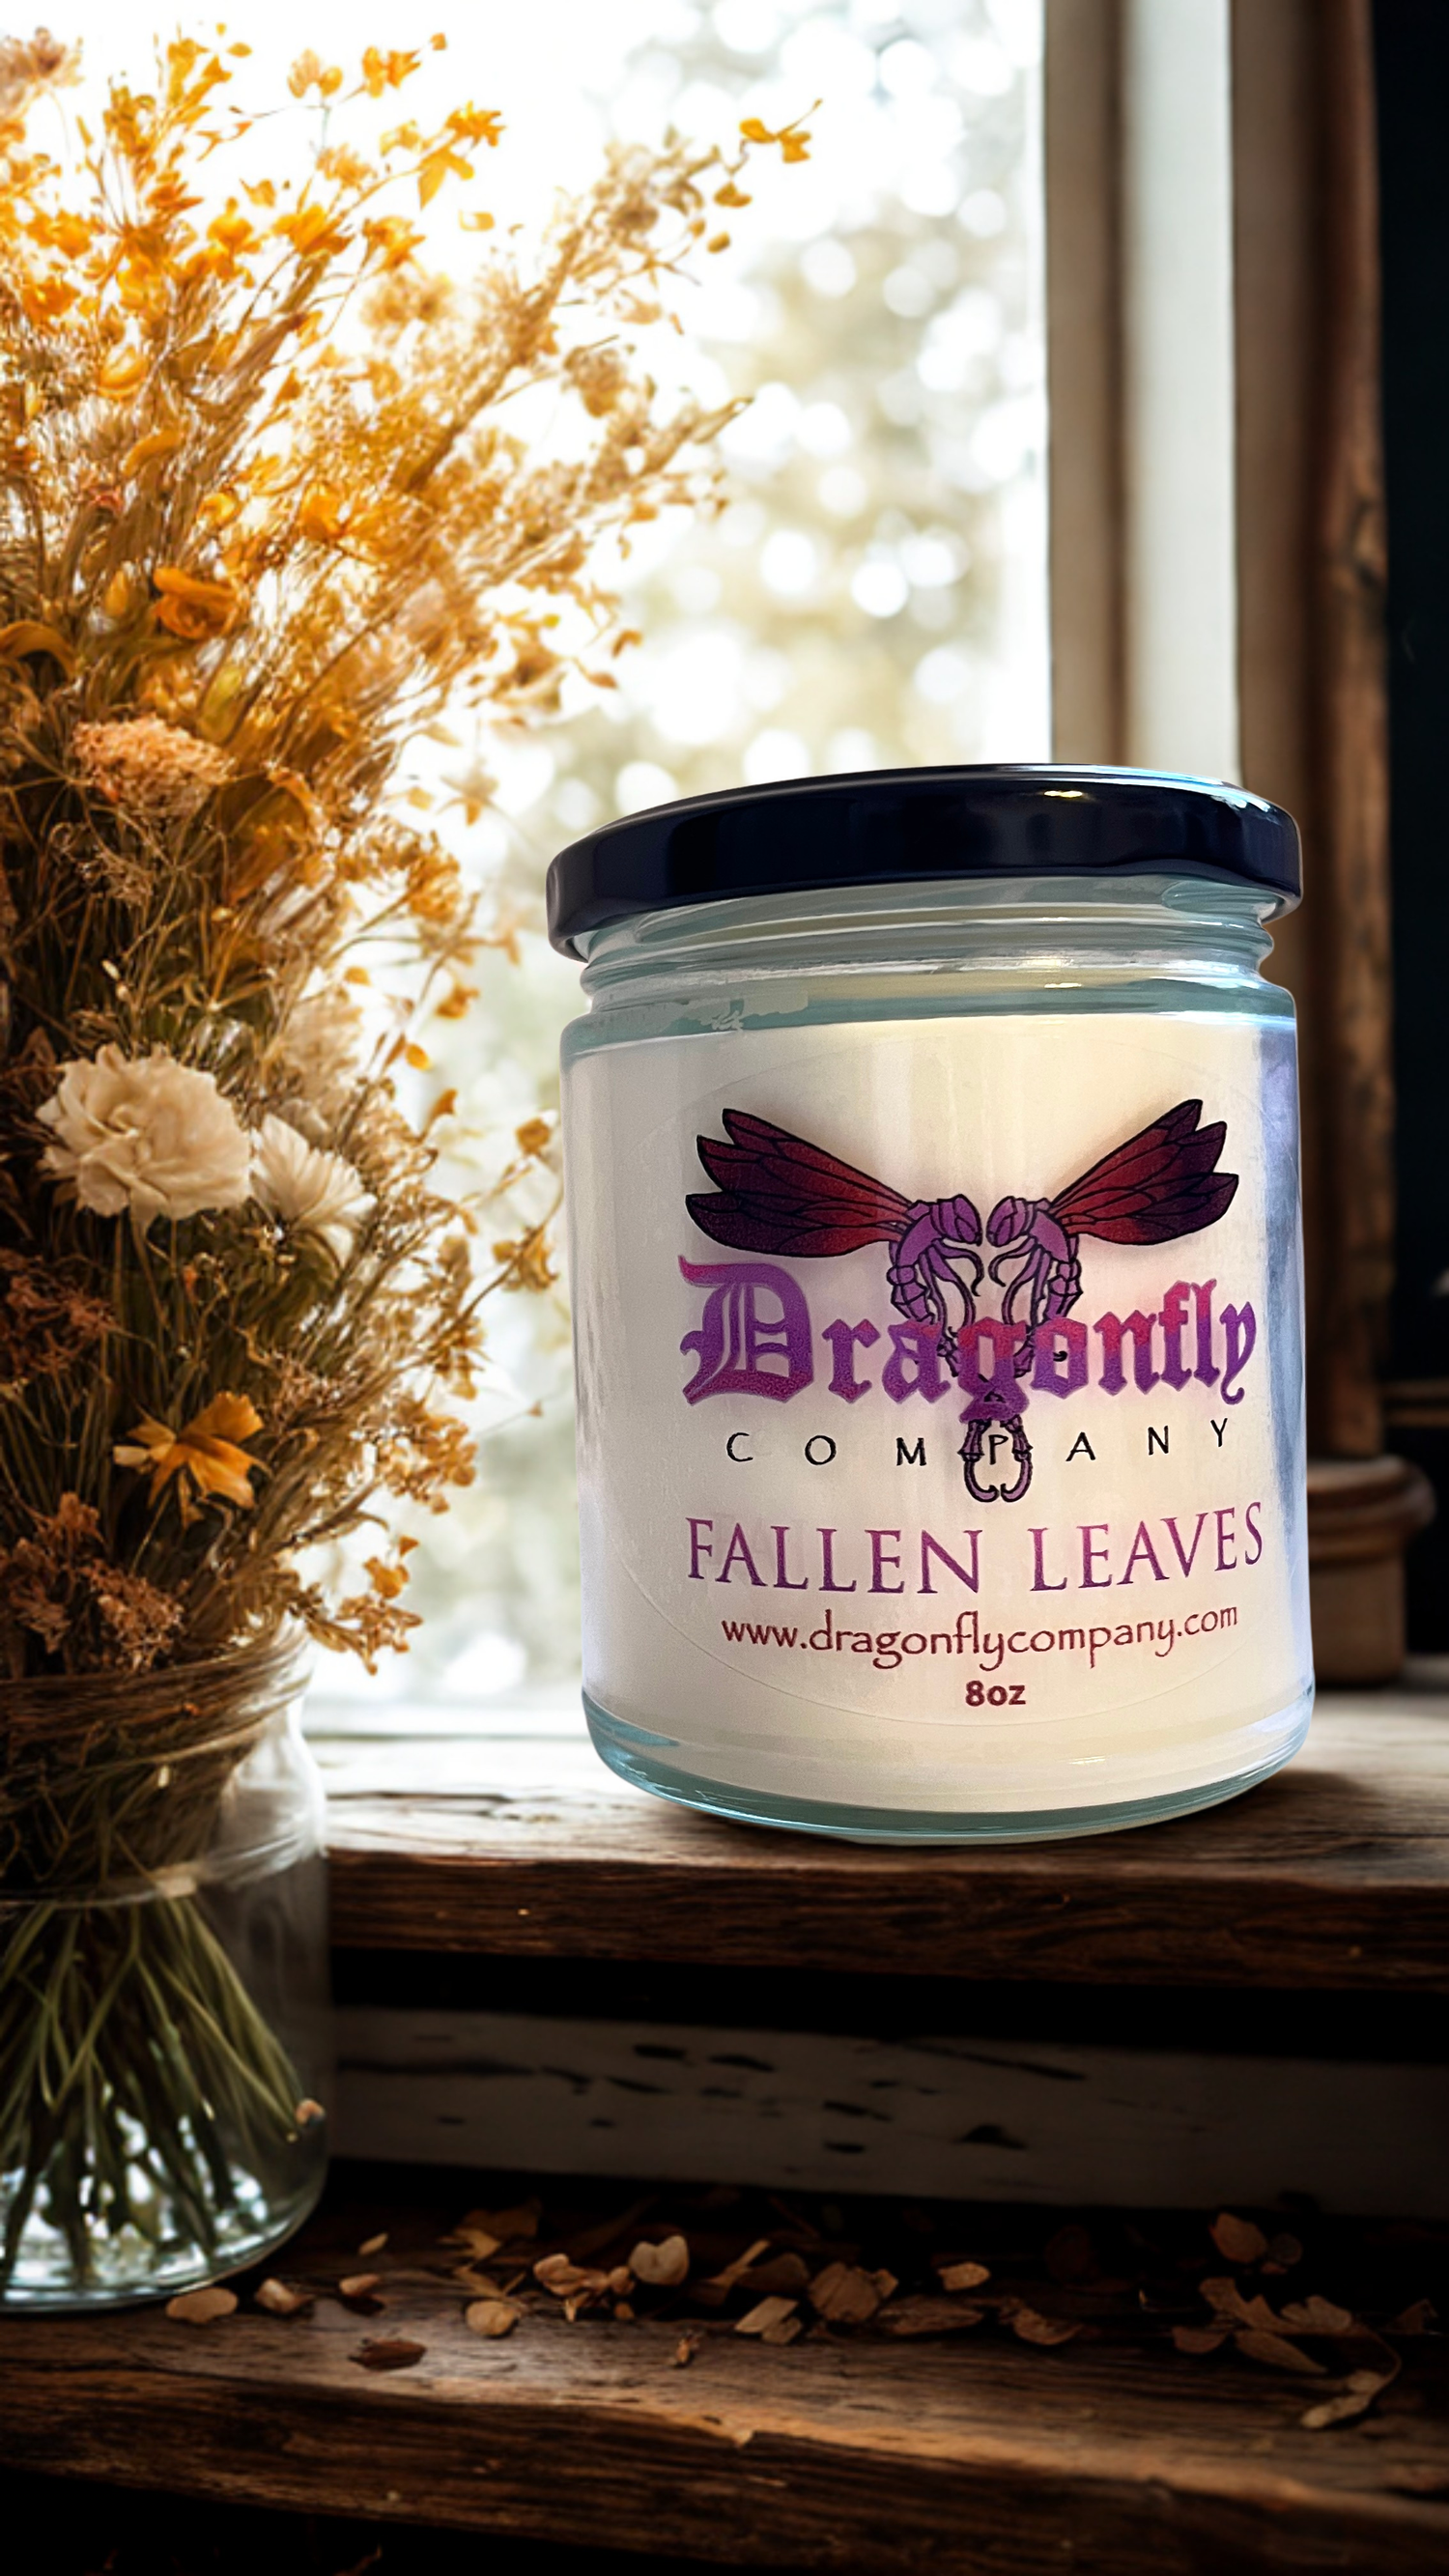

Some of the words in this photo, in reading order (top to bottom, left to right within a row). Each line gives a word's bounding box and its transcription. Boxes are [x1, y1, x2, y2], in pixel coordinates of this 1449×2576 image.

[678, 1255, 1257, 1425] Dragonfly
[725, 1418, 1229, 1467] COMPANY
[685, 1516, 983, 1595] FALLEN
[1028, 1501, 1264, 1593] LEAVES
[721, 1604, 1238, 1671] www.dragonflycompany.com
[965, 1681, 1027, 1707] 8oz
